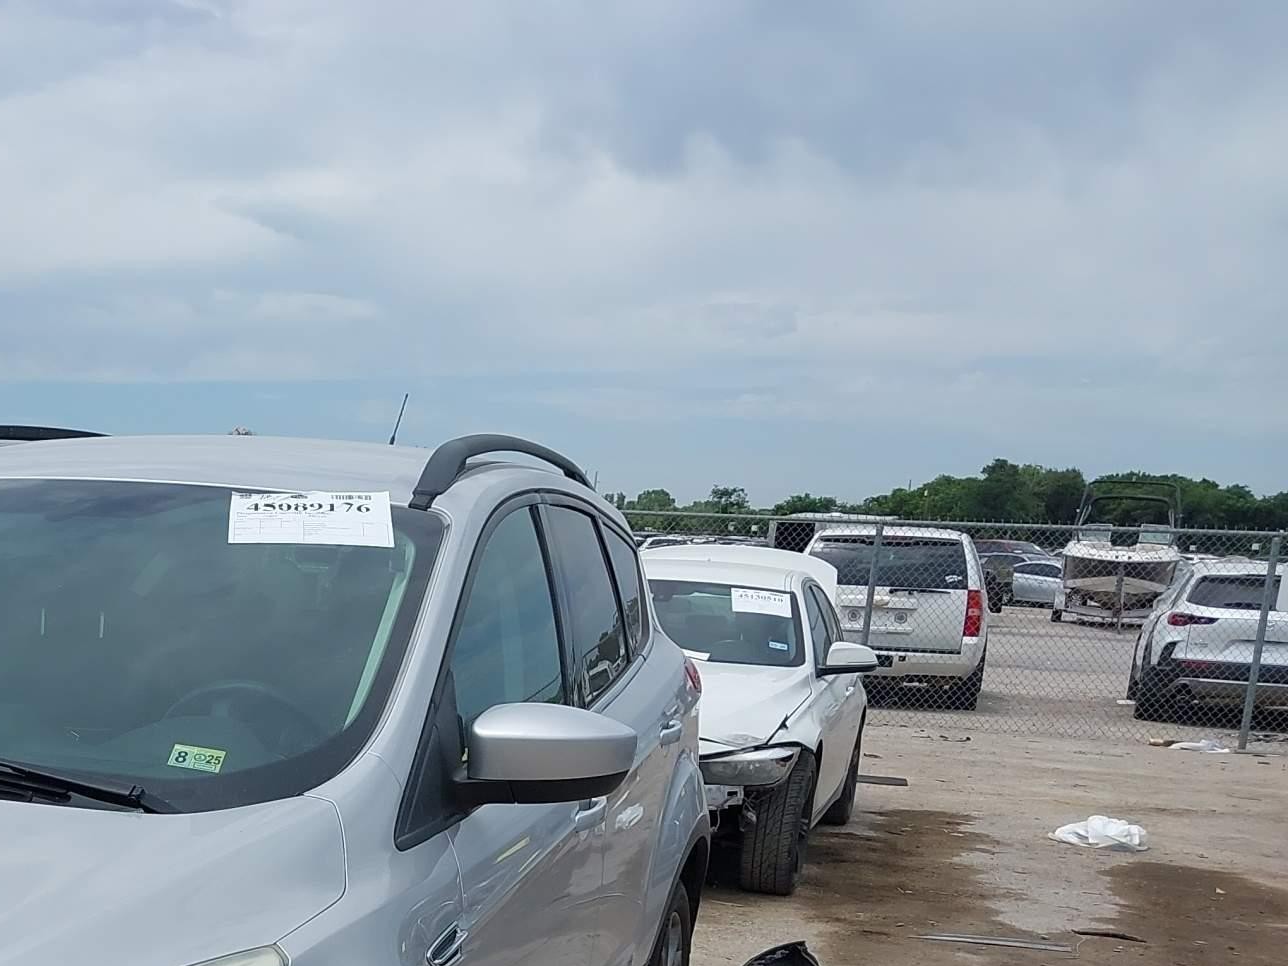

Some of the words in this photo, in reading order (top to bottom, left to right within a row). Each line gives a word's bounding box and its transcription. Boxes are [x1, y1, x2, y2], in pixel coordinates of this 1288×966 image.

[246, 502, 371, 514] 45089176
[174, 750, 189, 764] 8
[205, 754, 222, 766] 25
